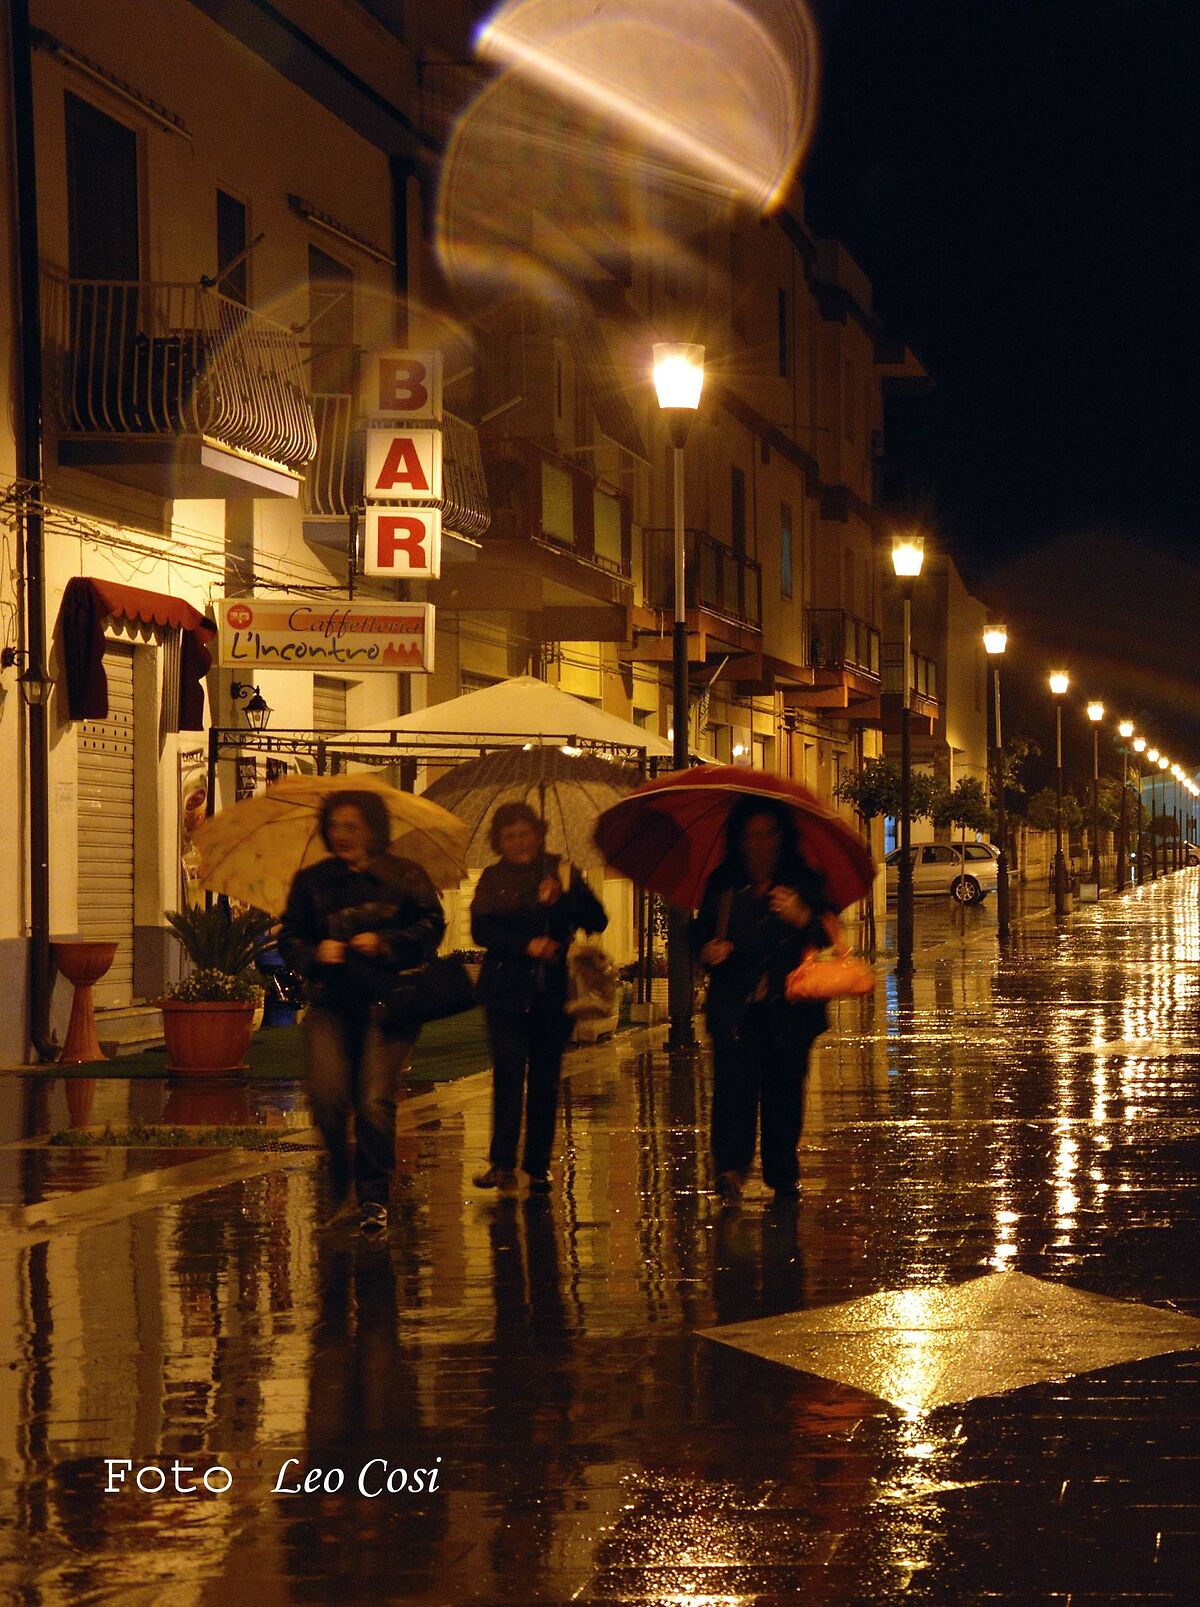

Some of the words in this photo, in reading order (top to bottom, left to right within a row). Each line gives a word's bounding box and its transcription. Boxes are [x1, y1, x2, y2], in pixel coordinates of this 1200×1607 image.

[375, 358, 429, 569] BAR
[288, 607, 420, 638] Caffetteria
[231, 632, 380, 662] L'Incontro
